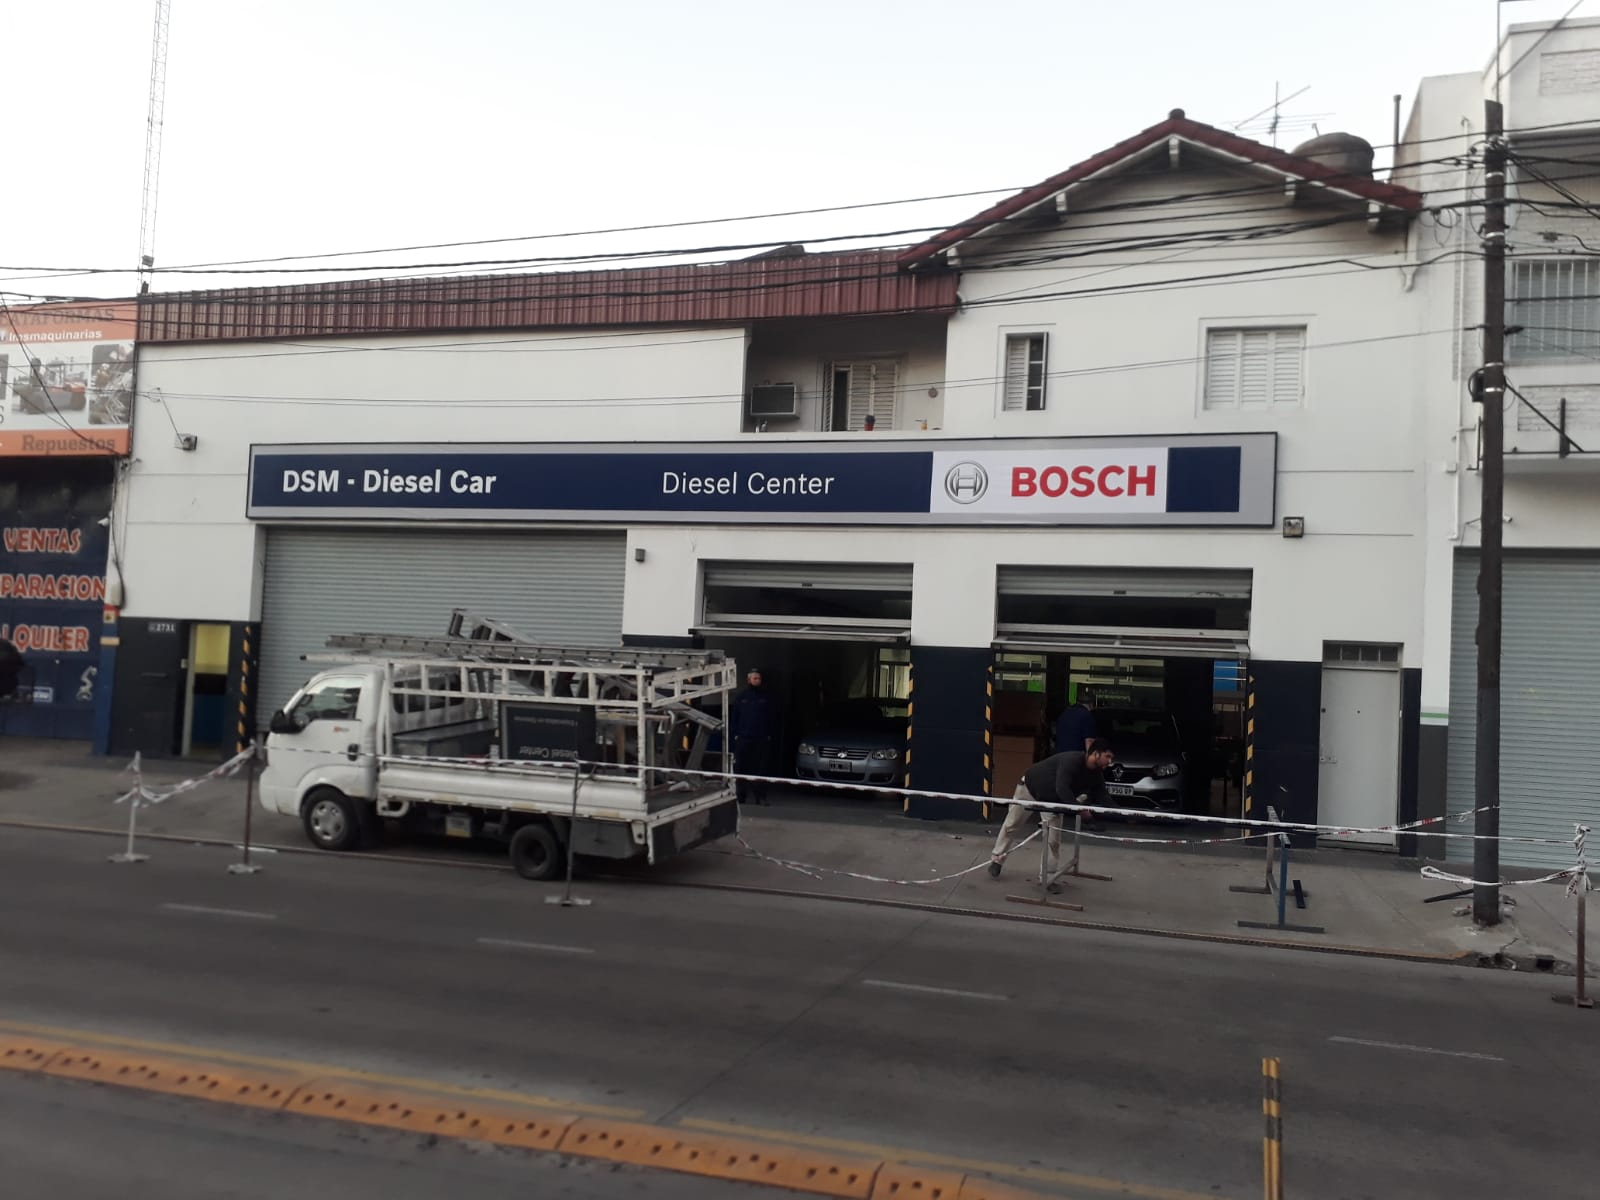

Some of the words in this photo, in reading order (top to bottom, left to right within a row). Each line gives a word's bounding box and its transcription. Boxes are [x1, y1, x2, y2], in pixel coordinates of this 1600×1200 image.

[22, 434, 116, 455] Repuestos
[283, 469, 339, 493] DSM
[363, 468, 441, 493] Diesel
[450, 470, 497, 494] Car
[662, 471, 737, 495] Diesel
[747, 471, 835, 495] Center
[1011, 465, 1156, 498] BOSCH
[4, 528, 81, 553] VENTAS
